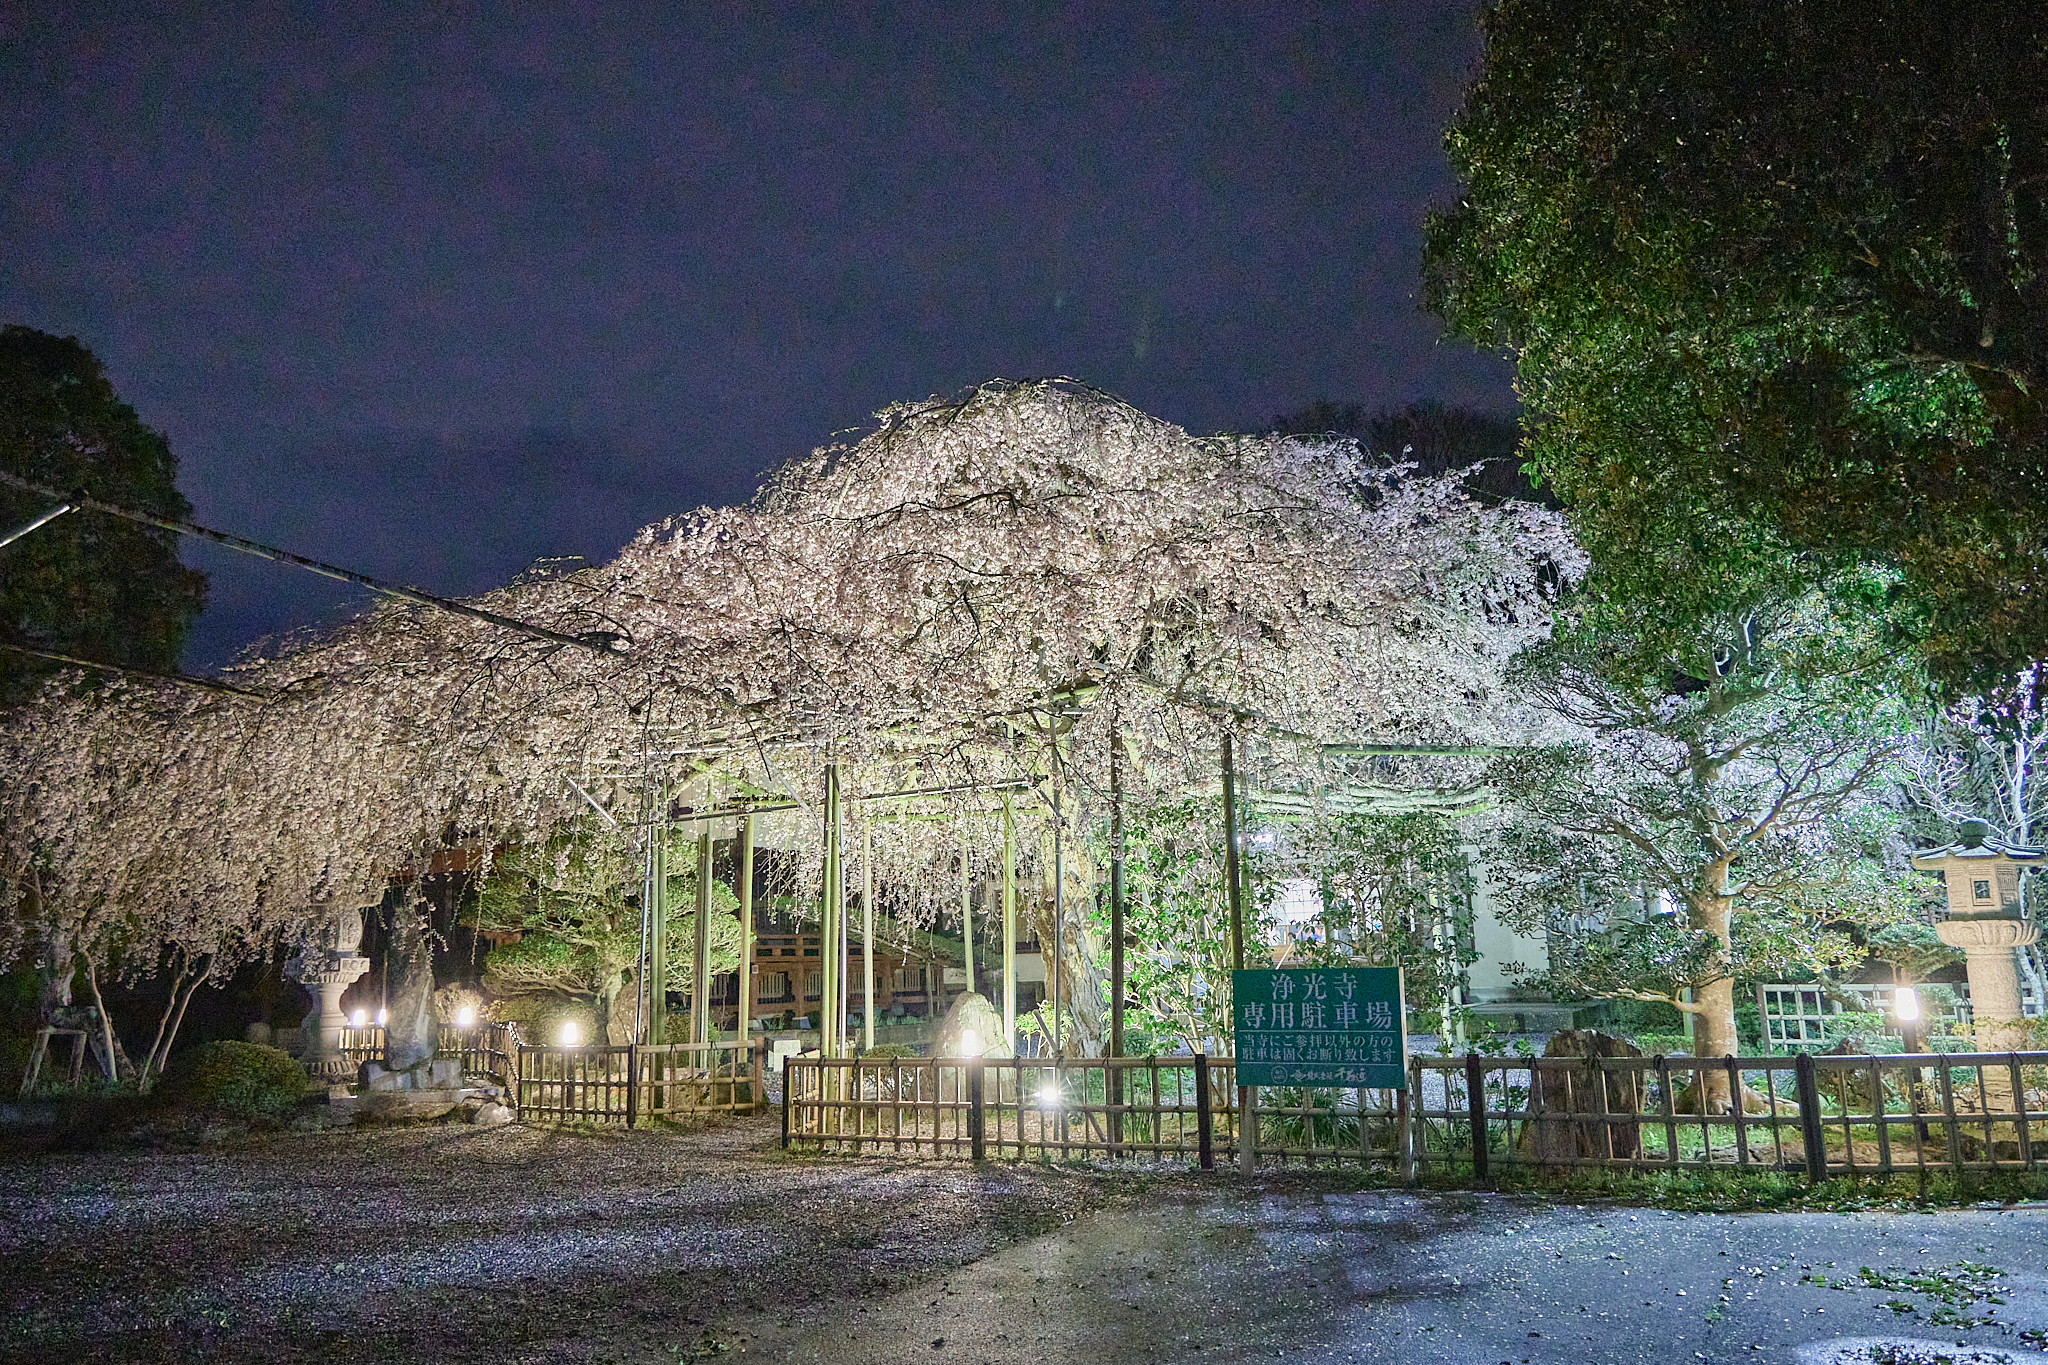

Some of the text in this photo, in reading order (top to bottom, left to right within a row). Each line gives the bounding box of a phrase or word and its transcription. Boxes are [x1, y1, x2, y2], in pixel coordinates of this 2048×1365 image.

[1270, 972, 1358, 1001] 浄光寺
[1241, 1001, 1393, 1029] 専用駐車場
[1243, 1034, 1393, 1048] 当寺にご参拝以外の方の
[1242, 1048, 1396, 1063] 駐車は固くお断り致します
